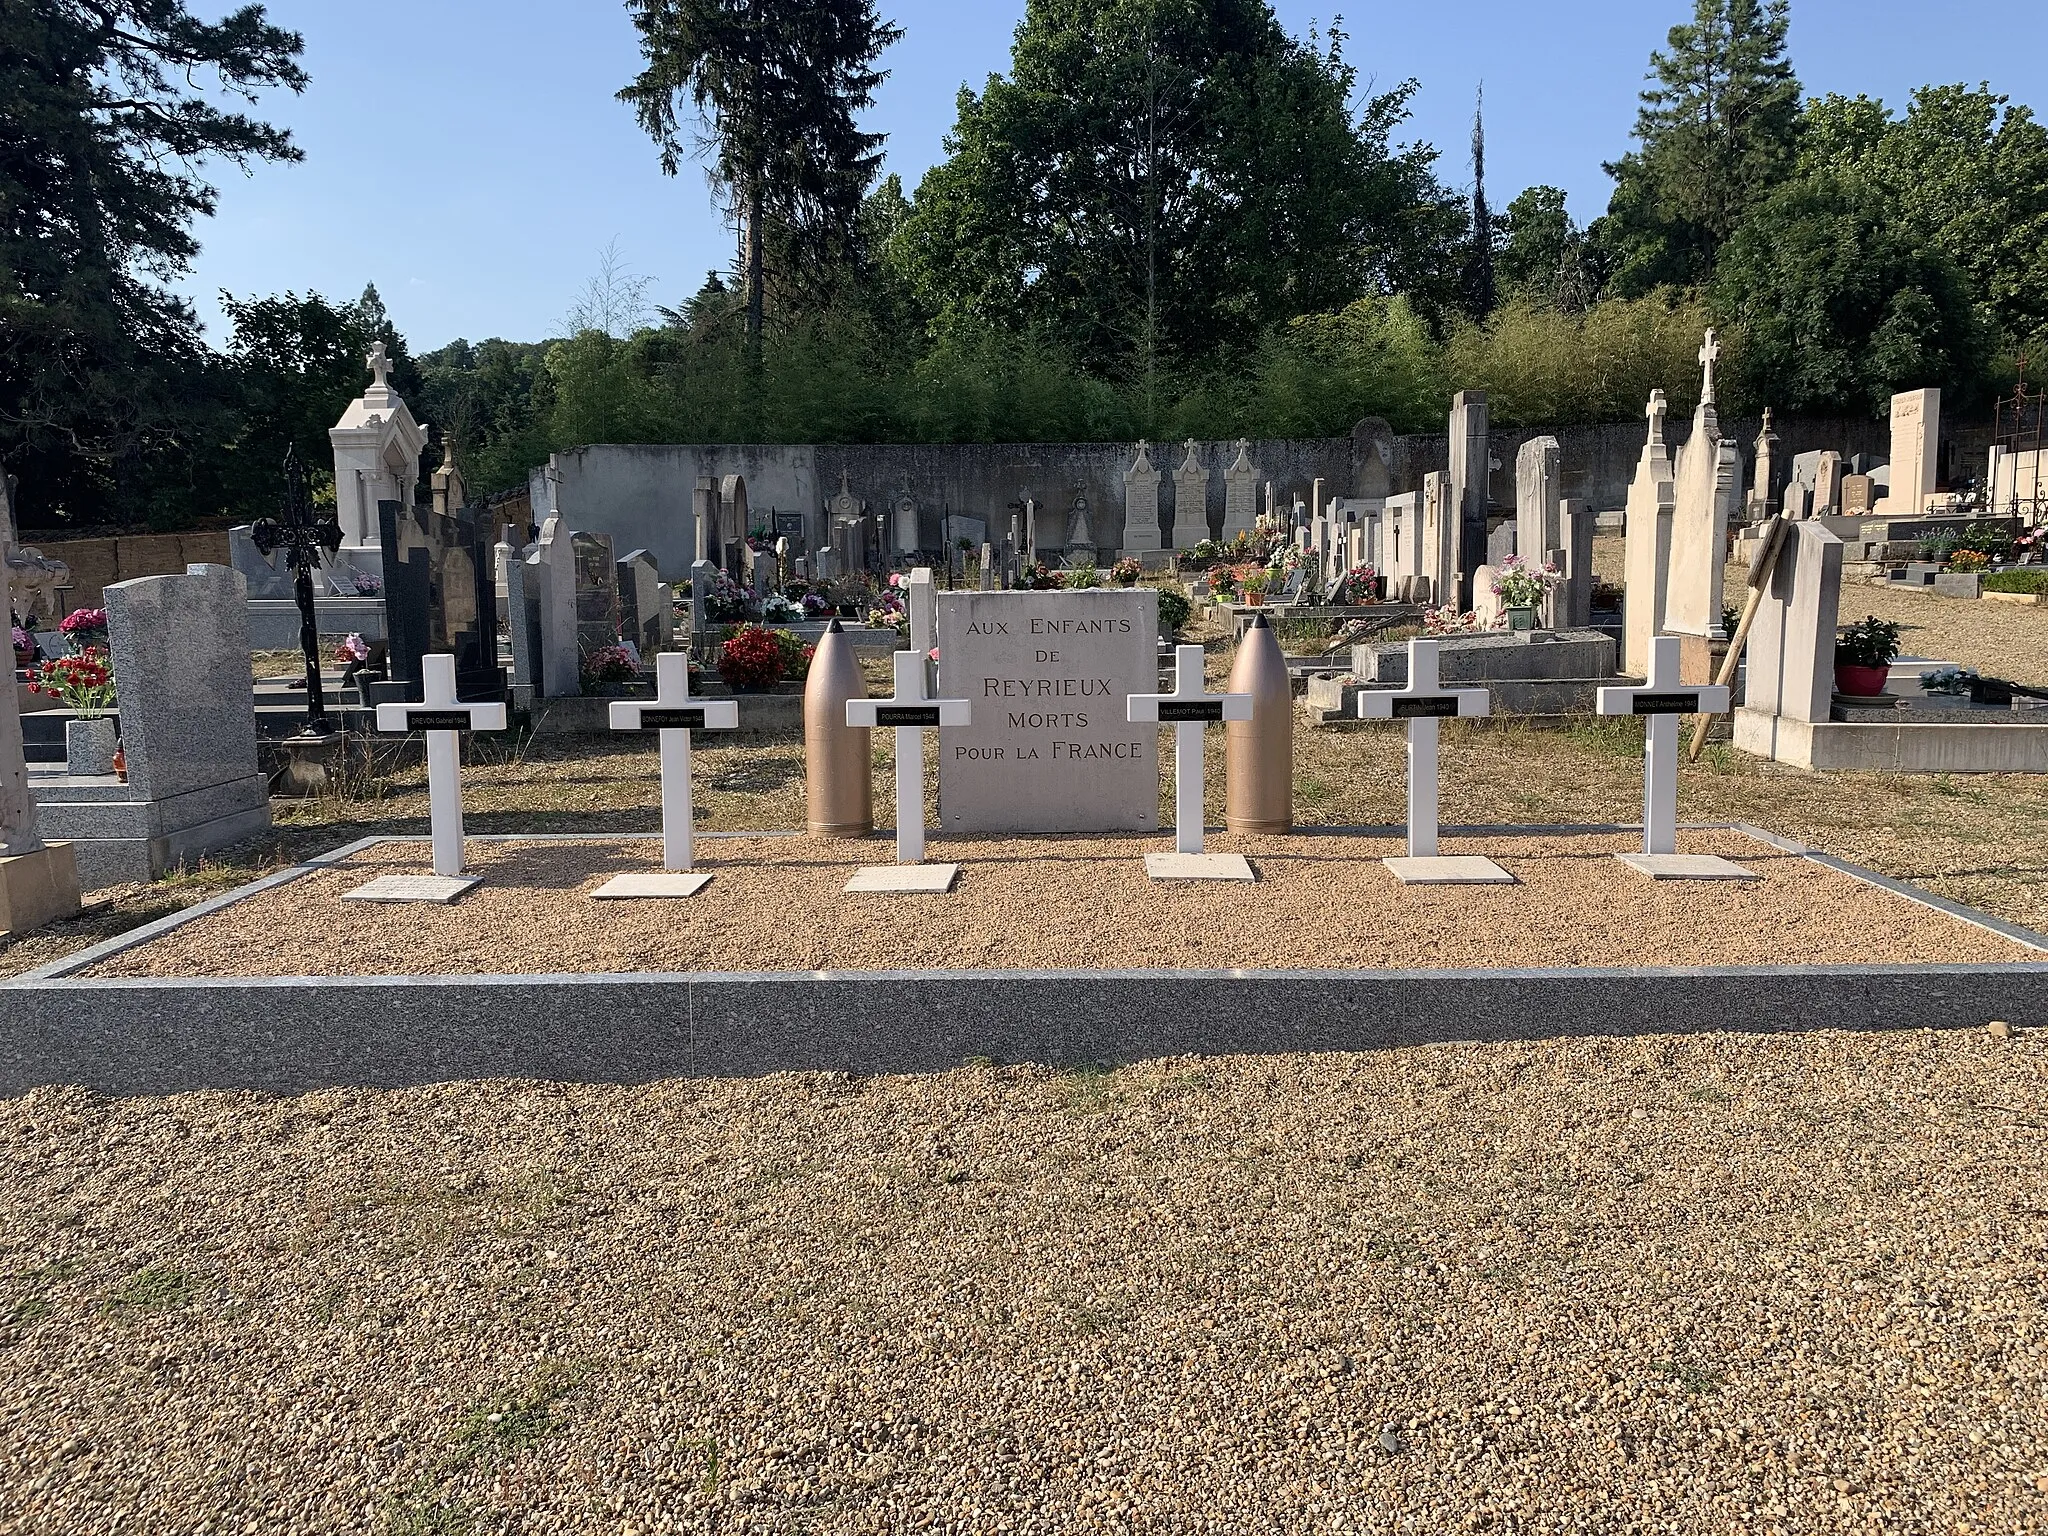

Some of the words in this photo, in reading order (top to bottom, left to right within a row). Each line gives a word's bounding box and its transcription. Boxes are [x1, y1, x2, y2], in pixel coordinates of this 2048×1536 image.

[966, 621, 1009, 635] AUX
[1030, 618, 1131, 634] ENFANTS
[1035, 650, 1060, 663] DE
[983, 677, 1112, 697] REYRIEUX
[1008, 712, 1089, 728] MORTS
[955, 746, 1005, 760] POUR
[1016, 747, 1039, 760] LA
[1052, 741, 1142, 759] FRANCE
